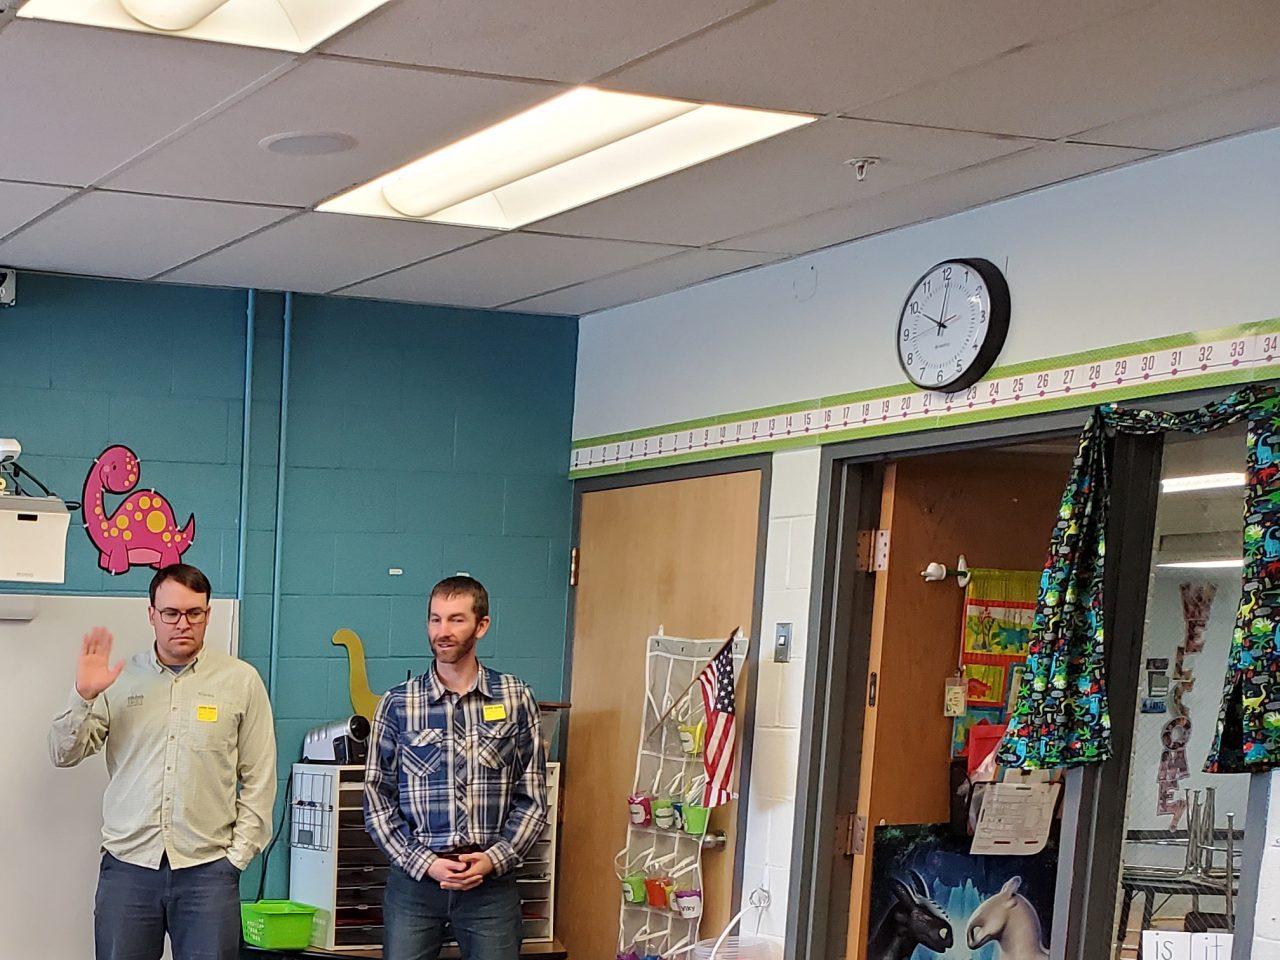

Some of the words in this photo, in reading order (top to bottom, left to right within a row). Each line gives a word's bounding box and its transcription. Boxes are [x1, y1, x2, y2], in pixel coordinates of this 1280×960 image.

[942, 267, 953, 280] 12
[964, 271, 969, 283] 1
[923, 280, 931, 293] 11
[975, 286, 983, 298] 2
[910, 301, 919, 315] 10
[980, 310, 986, 323] 3
[903, 328, 910, 342] 9
[906, 352, 913, 365] 8
[956, 359, 963, 373] 5
[919, 367, 926, 380] 7
[937, 370, 944, 382] 6
[602, 447, 607, 457] 2
[616, 445, 620, 455] 3
[644, 440, 648, 450] 5
[674, 434, 678, 445] 7
[705, 429, 709, 441] 9
[720, 427, 726, 438] 10
[736, 424, 742, 435] 11
[752, 421, 759, 433] 12
[768, 418, 776, 430] 13
[786, 416, 793, 428] 14
[804, 413, 811, 425] 15
[824, 409, 831, 422] 16
[842, 407, 850, 419] 17
[862, 404, 870, 416] 18
[882, 400, 890, 413] 19
[901, 396, 911, 410] 20
[923, 393, 932, 407] 21
[945, 392, 955, 404] 22
[966, 386, 977, 400] 23
[989, 382, 1000, 397] 24
[1013, 377, 1025, 393] 25
[1037, 373, 1050, 389] 26
[1063, 369, 1075, 385] 27
[1089, 365, 1101, 380] 28
[1115, 360, 1127, 375] 29
[1142, 355, 1155, 371] 30
[1170, 351, 1183, 366] 31
[1199, 346, 1213, 362] 32
[1230, 341, 1245, 357] 33
[1263, 336, 1278, 353] 34
